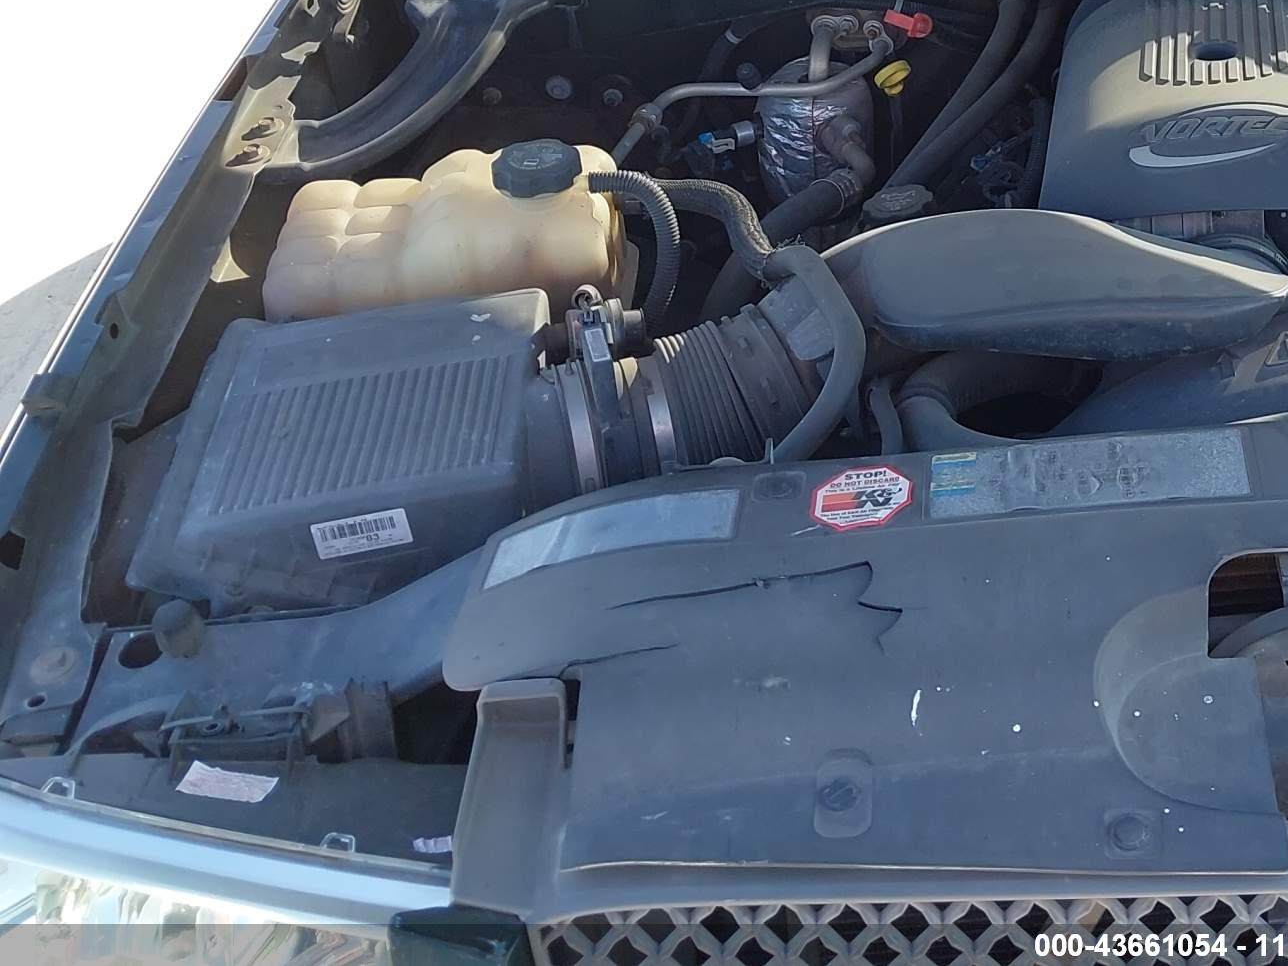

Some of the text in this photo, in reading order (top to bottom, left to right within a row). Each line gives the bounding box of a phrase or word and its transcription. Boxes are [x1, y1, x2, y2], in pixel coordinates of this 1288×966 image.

[844, 470, 887, 481] STOP!
[844, 480, 862, 488] NOT
[863, 476, 900, 486] DISCARD
[852, 487, 903, 509] K&N
